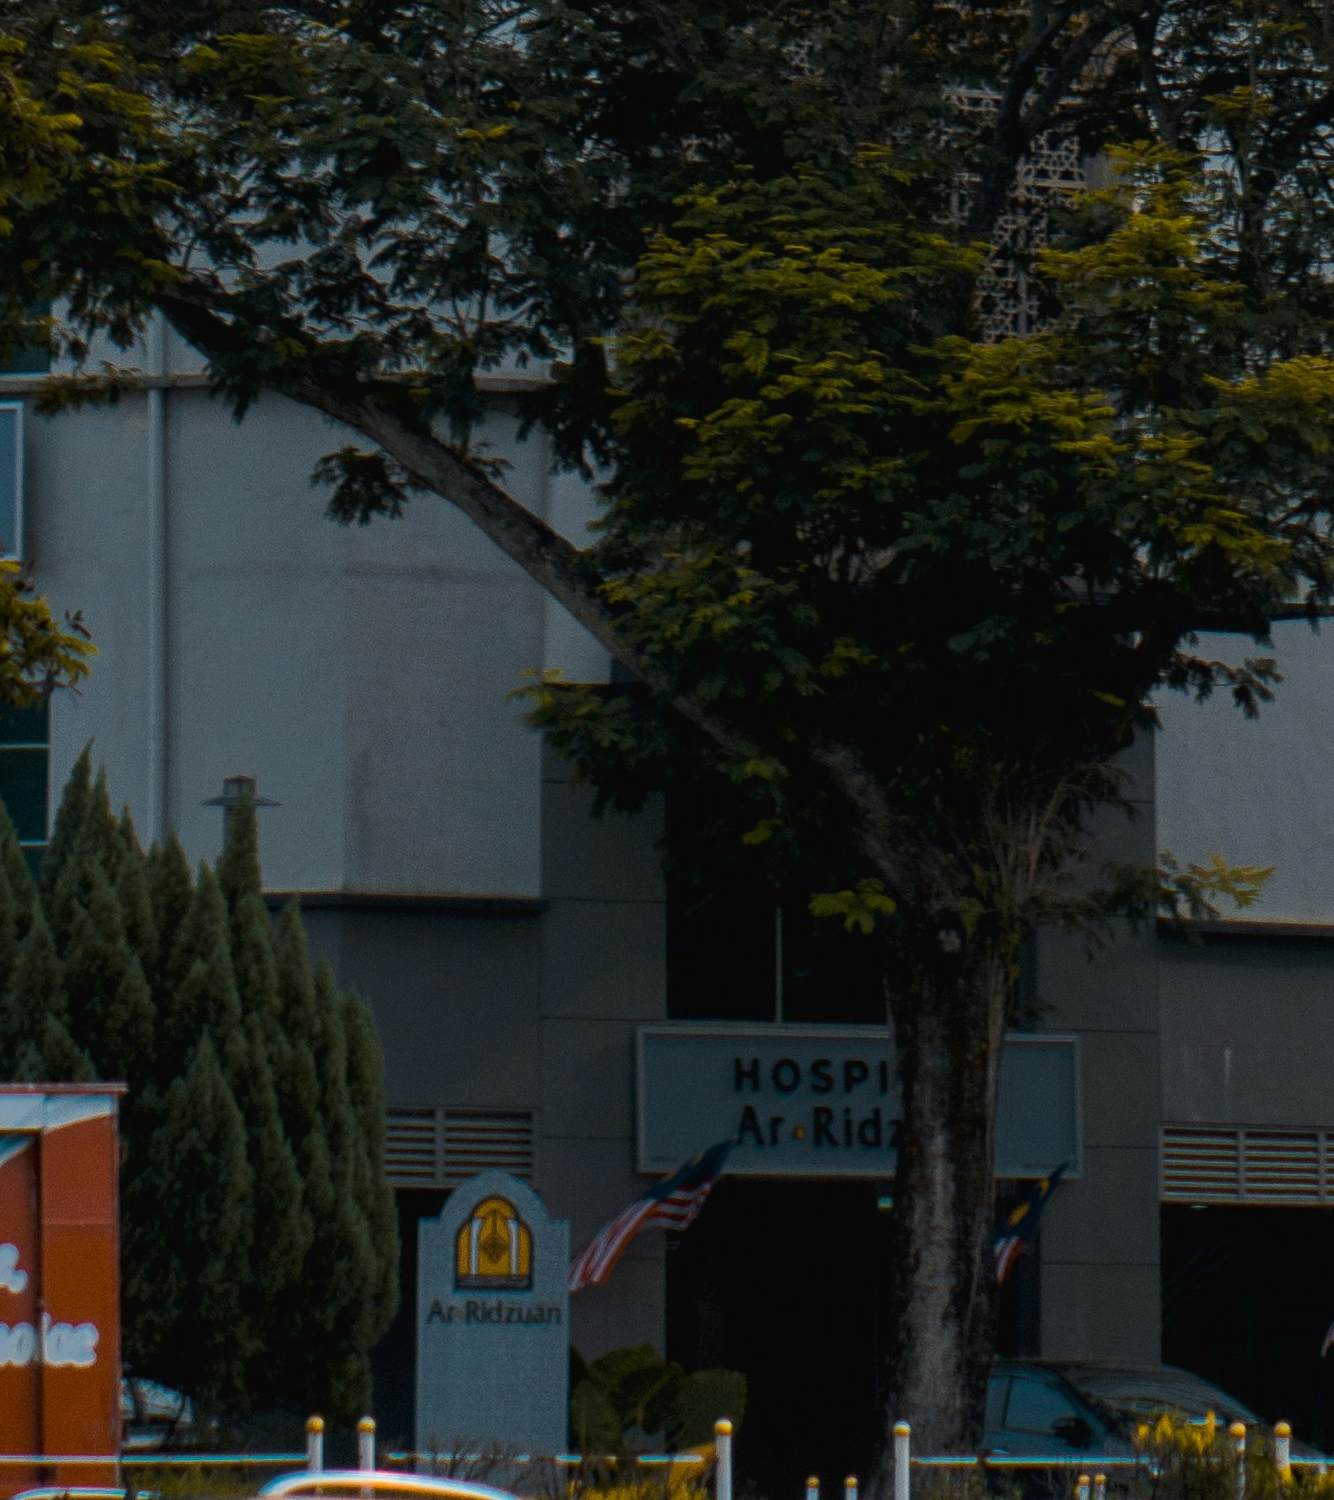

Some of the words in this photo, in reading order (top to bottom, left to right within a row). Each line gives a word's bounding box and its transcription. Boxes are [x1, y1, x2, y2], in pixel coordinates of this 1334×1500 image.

[734, 1056, 888, 1093] HOSPI
[812, 1104, 901, 1149] Ridz
[464, 1300, 562, 1325] Ridzuan
